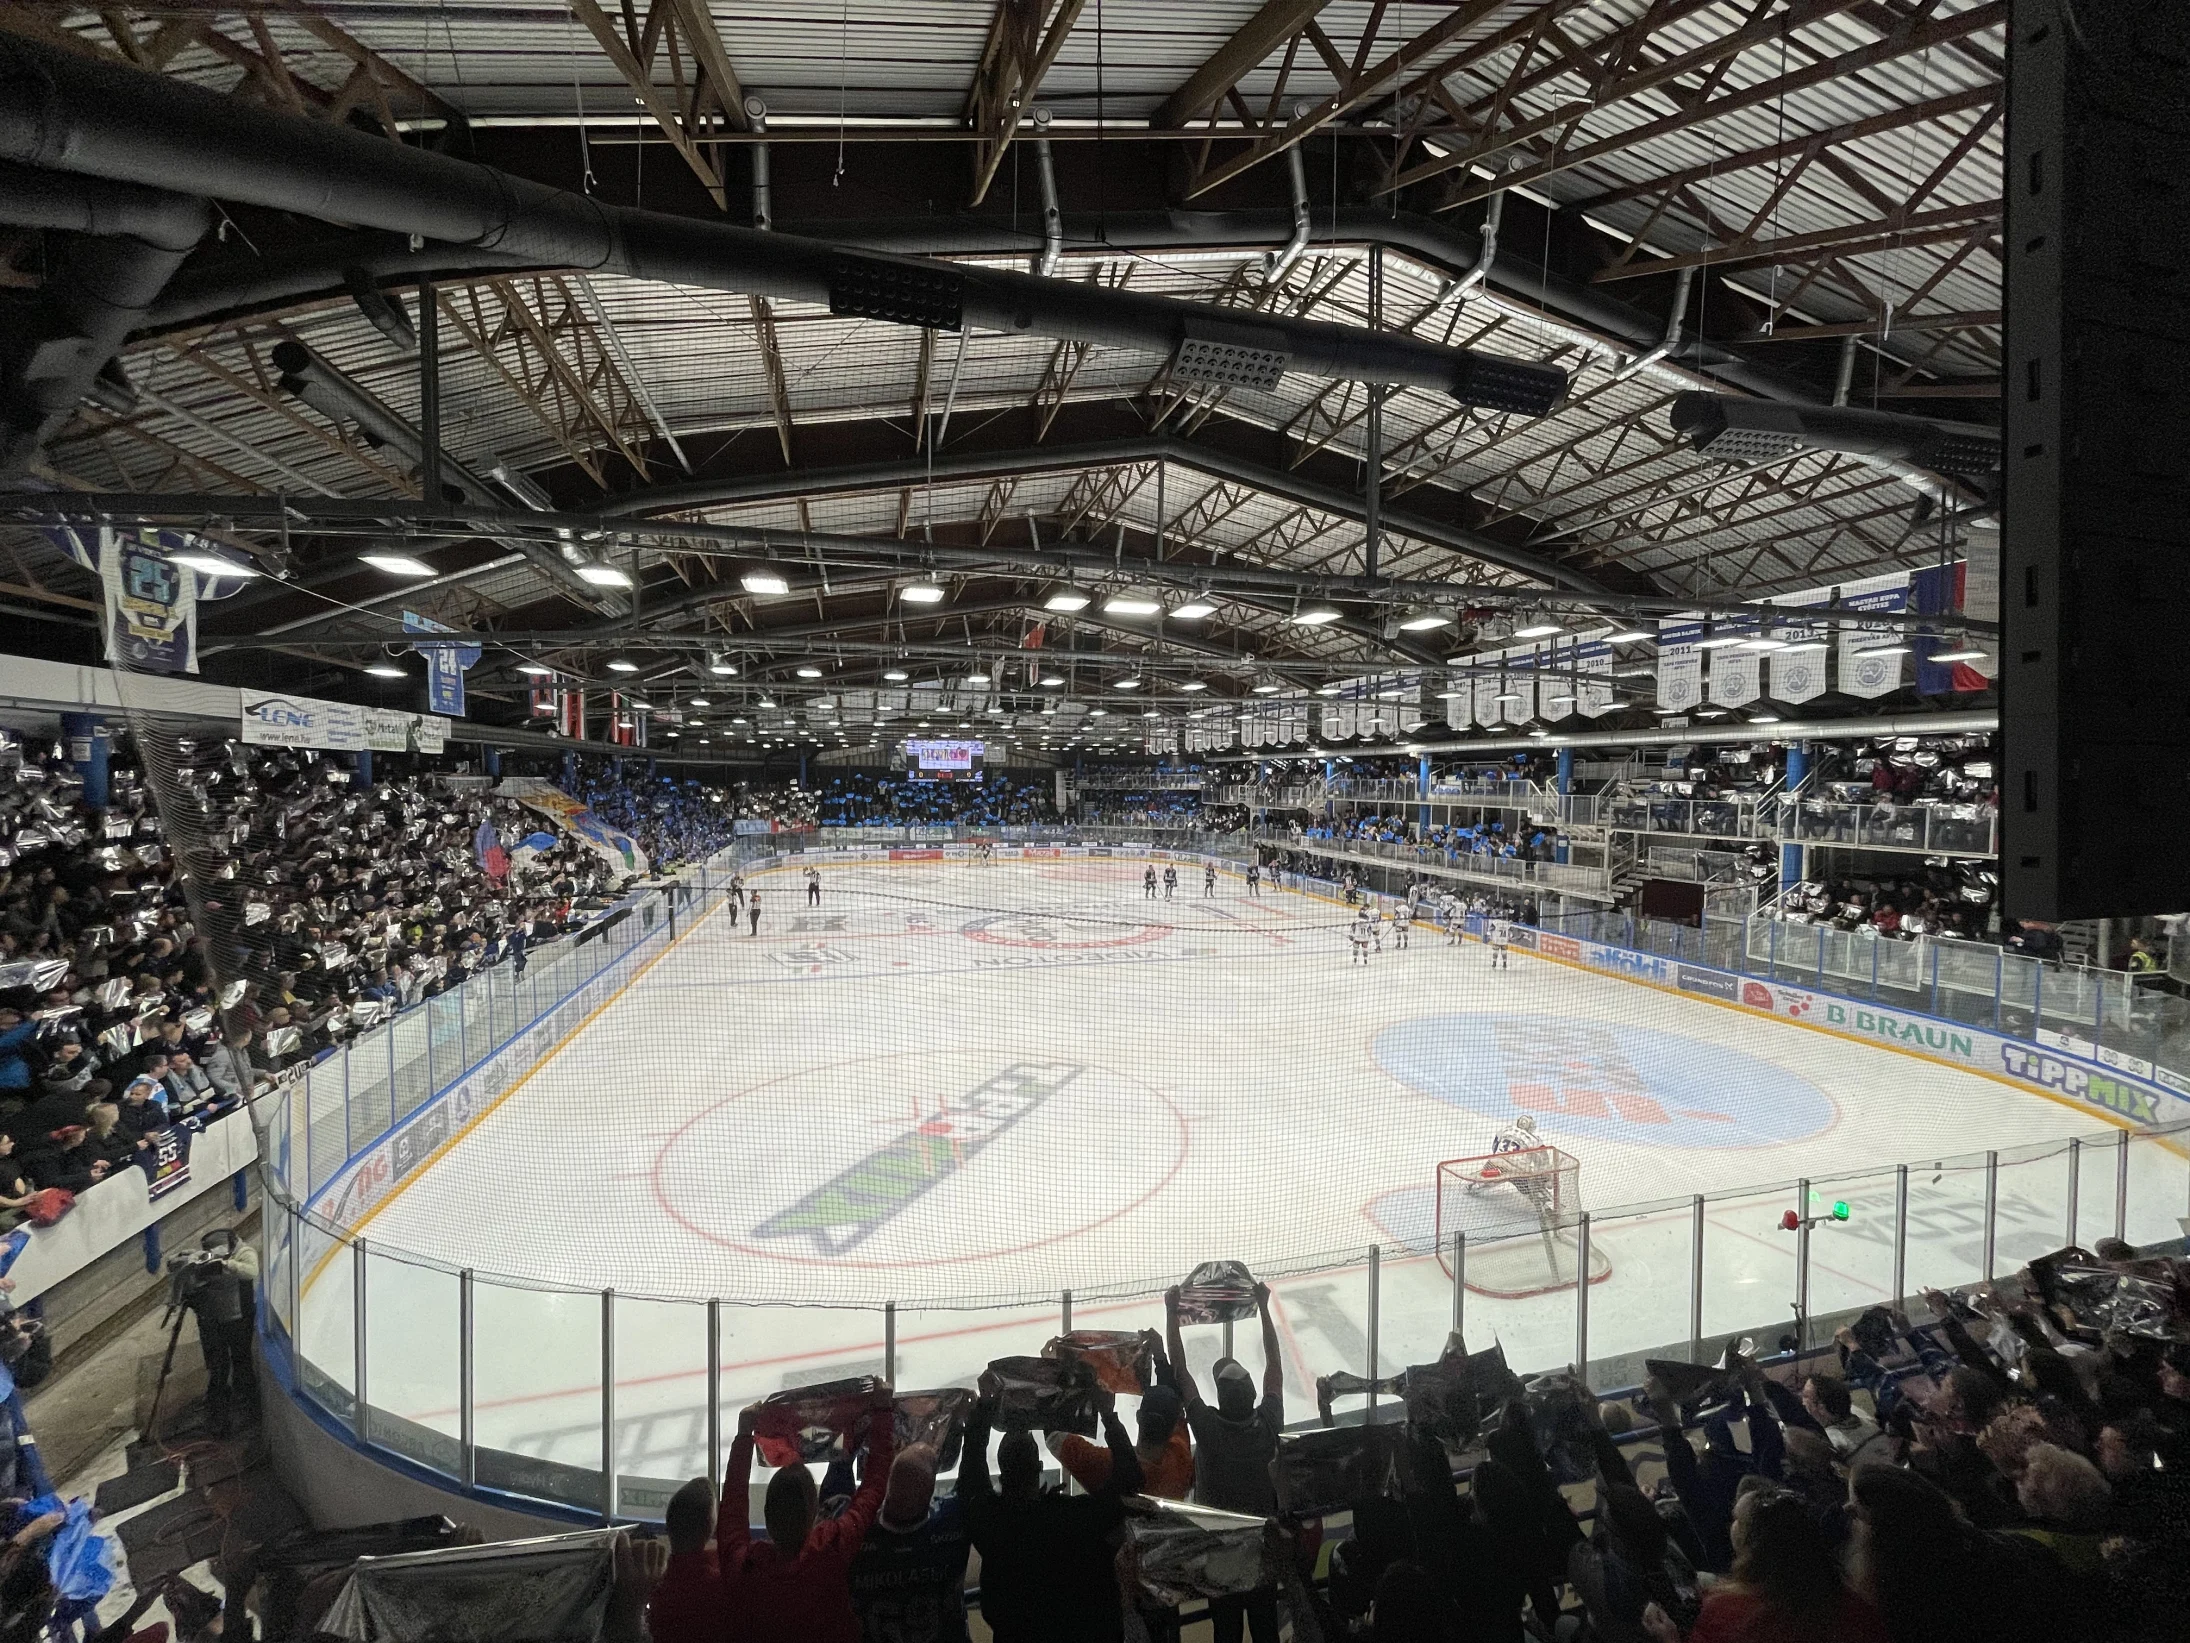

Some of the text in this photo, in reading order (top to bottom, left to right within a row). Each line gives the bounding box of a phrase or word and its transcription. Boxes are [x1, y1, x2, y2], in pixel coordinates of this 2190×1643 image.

[1785, 630, 1814, 641] 2013
[1670, 645, 1692, 656] 2011
[439, 648, 457, 676] 24
[260, 707, 316, 728] LENE
[1827, 1003, 1973, 1058] B BRAUN
